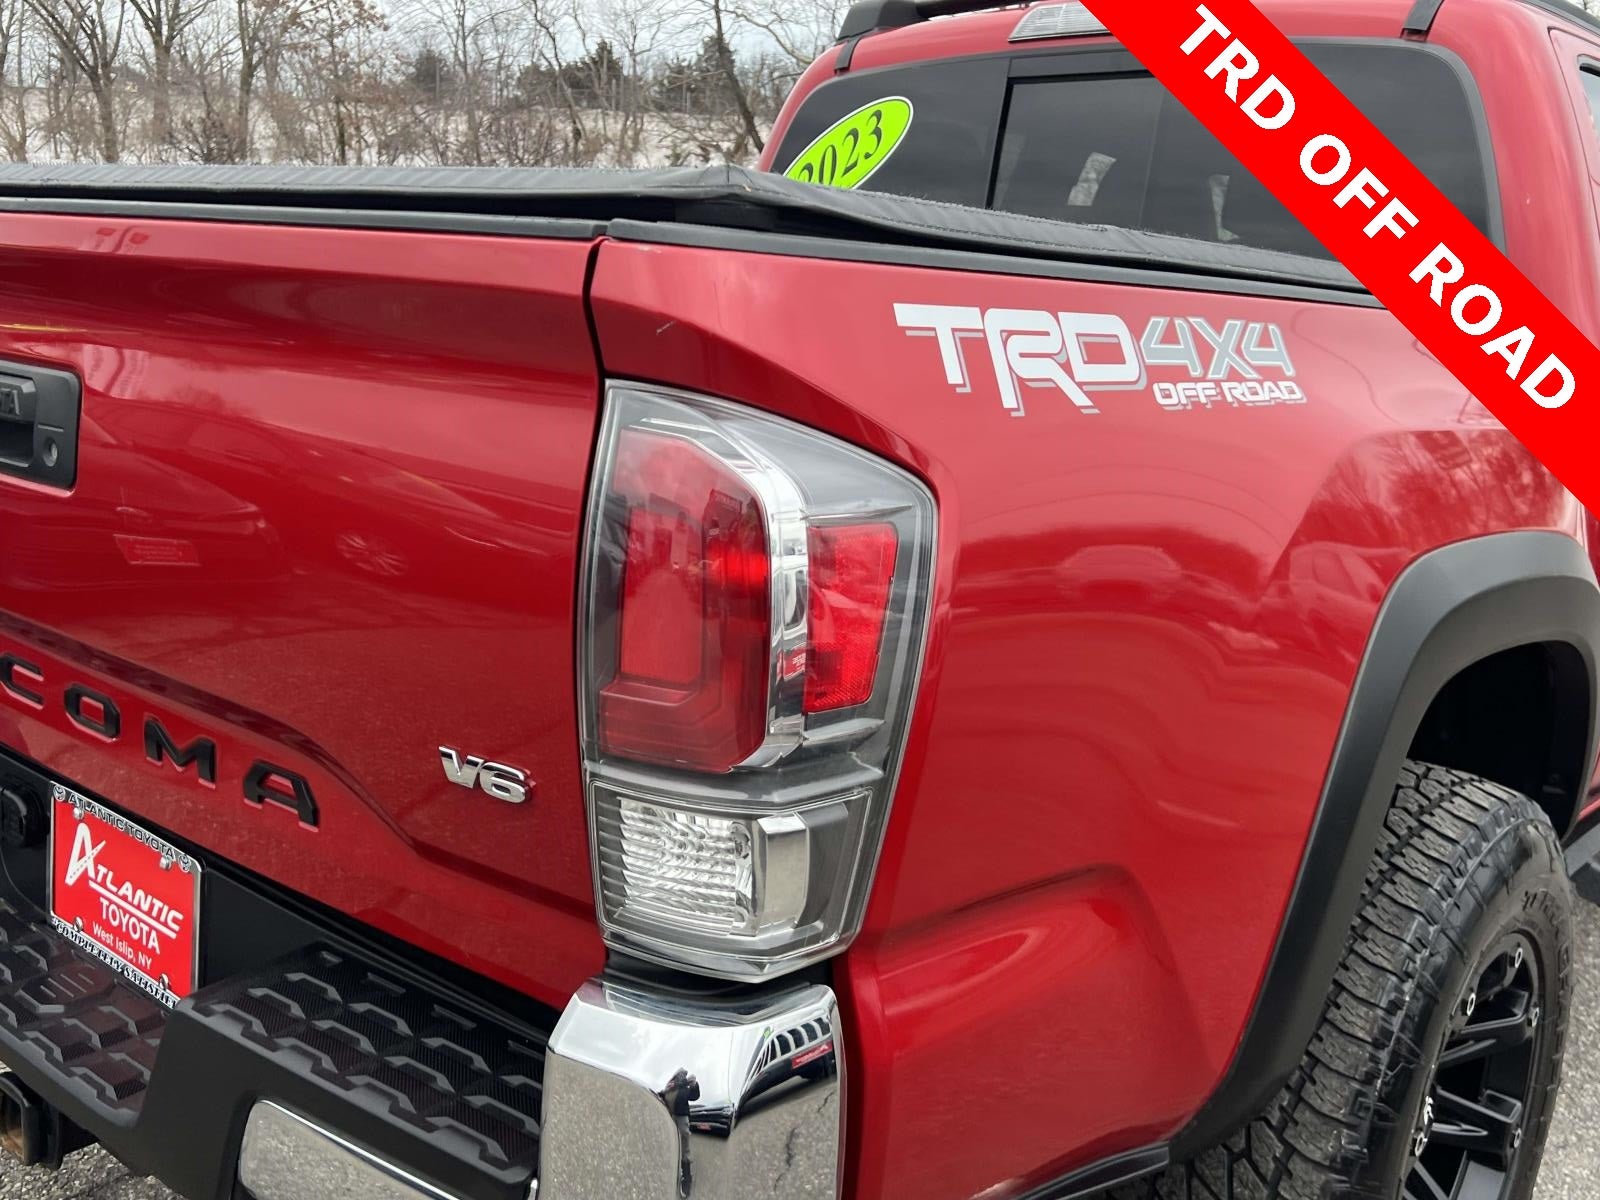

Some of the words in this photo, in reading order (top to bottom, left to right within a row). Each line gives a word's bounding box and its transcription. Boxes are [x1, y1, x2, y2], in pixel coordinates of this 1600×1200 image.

[893, 303, 1146, 417] TRD
[1152, 381, 1219, 410] OFF
[1222, 381, 1307, 408] ROAD
[438, 744, 534, 804] V6
[68, 793, 125, 831] ATLANTIC
[129, 824, 176, 859] TOYOTA
[65, 822, 184, 931] ATLANTIC
[92, 920, 114, 947] West
[138, 951, 153, 970] NY
[100, 896, 161, 955] TOYOTA
